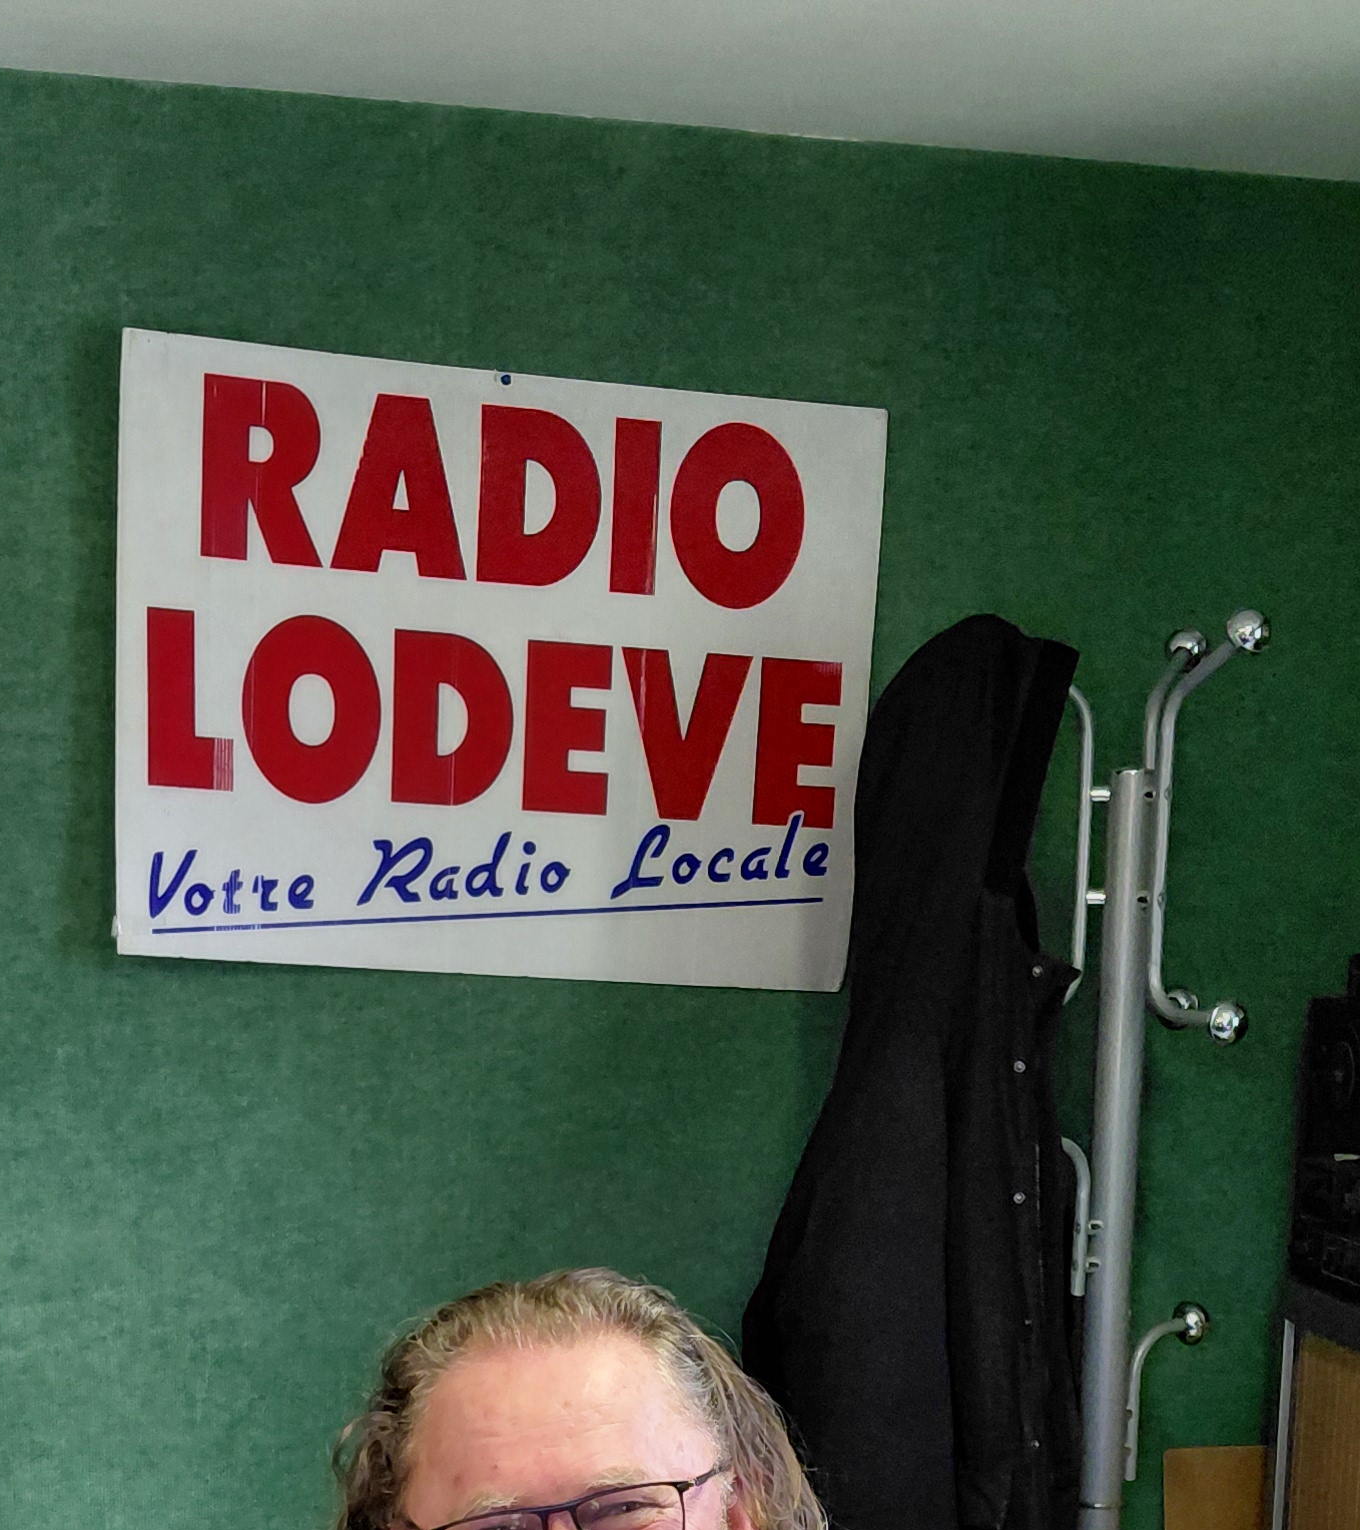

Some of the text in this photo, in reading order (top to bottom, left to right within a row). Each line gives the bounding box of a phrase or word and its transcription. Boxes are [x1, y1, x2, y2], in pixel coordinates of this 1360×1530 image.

[200, 372, 805, 610] RADIO
[146, 605, 843, 829] LODEVE
[147, 810, 830, 919] Votre Radio Locale
